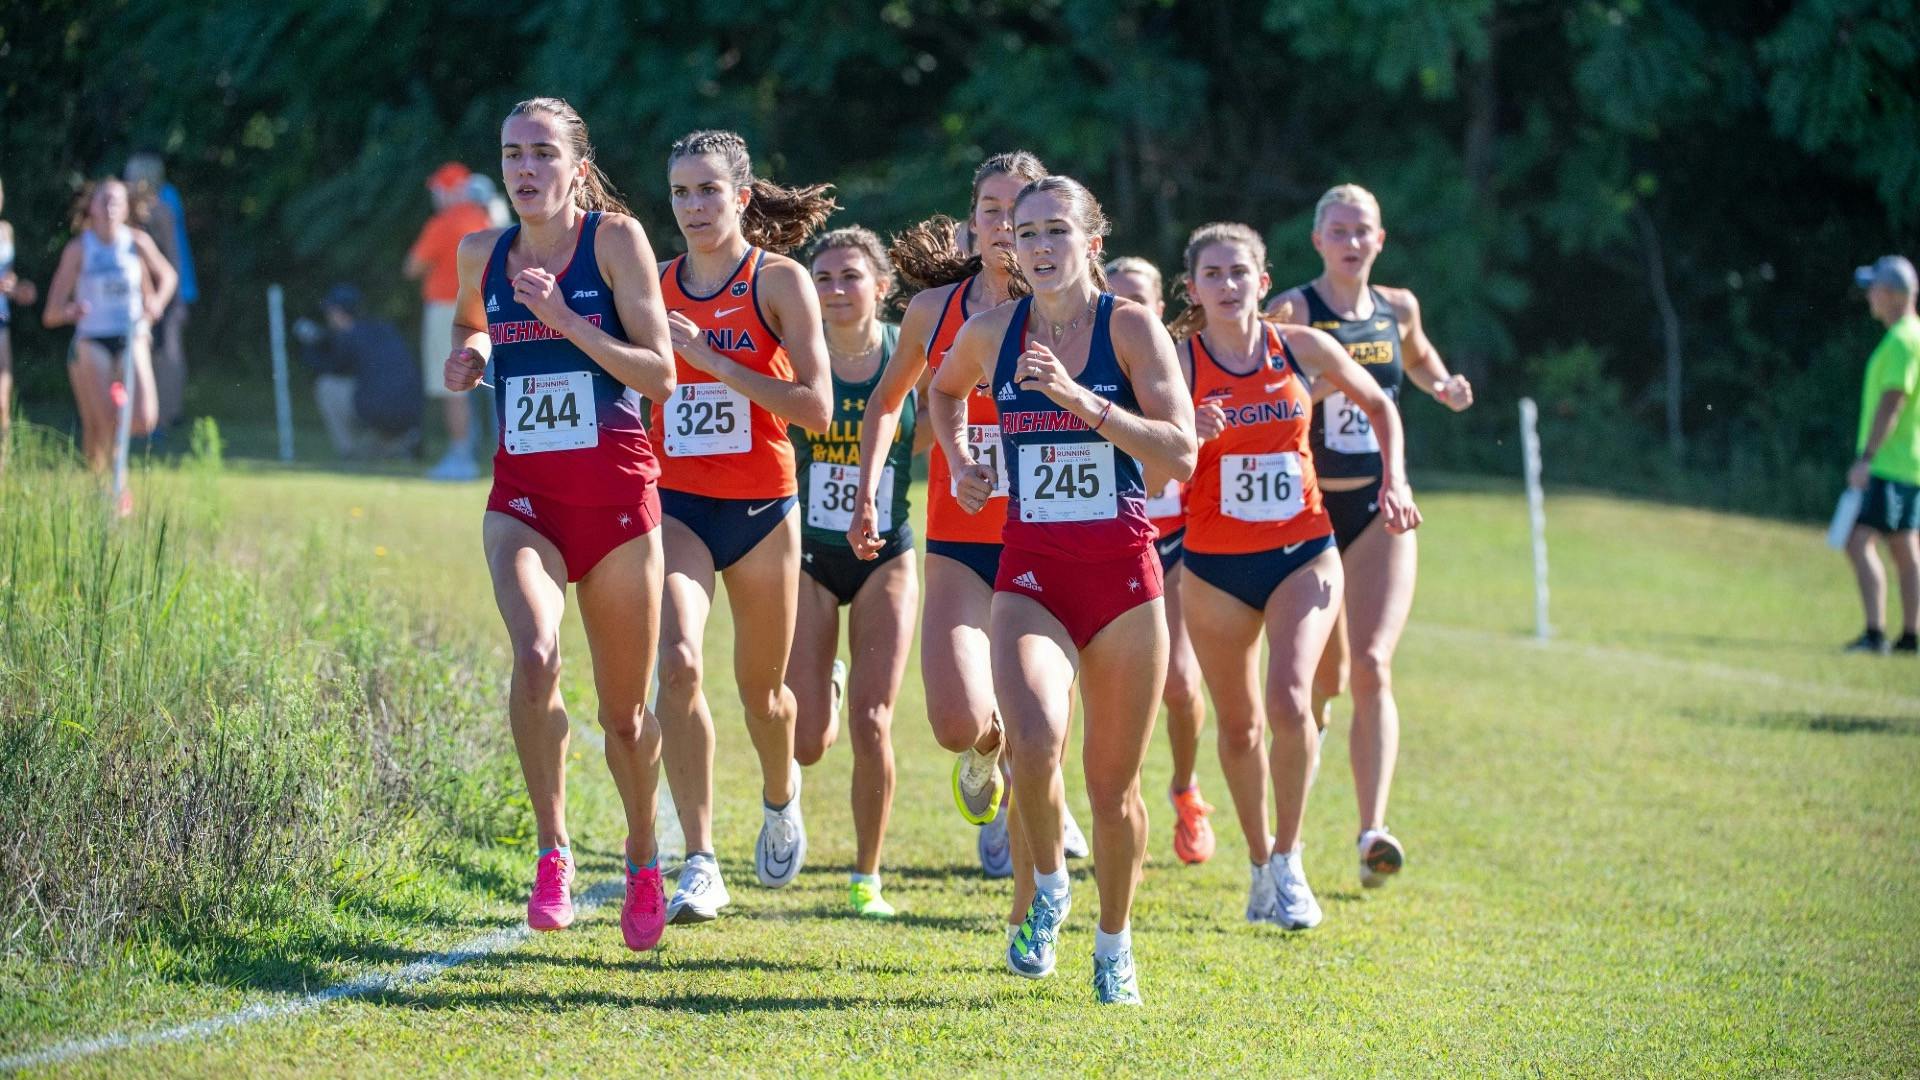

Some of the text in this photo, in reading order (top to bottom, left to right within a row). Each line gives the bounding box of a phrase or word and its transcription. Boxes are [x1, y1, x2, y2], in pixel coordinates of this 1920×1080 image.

[536, 379, 569, 388] RUNNING
[517, 392, 581, 432] 244
[676, 401, 735, 437] 325
[1002, 411, 1091, 434] RICHMO
[1222, 400, 1305, 427] RGINIA
[813, 444, 861, 464] &MA
[1056, 449, 1091, 457] RUNNING
[1034, 463, 1100, 500] 245
[1235, 471, 1291, 502] 316
[1012, 578, 1043, 592] adidas
